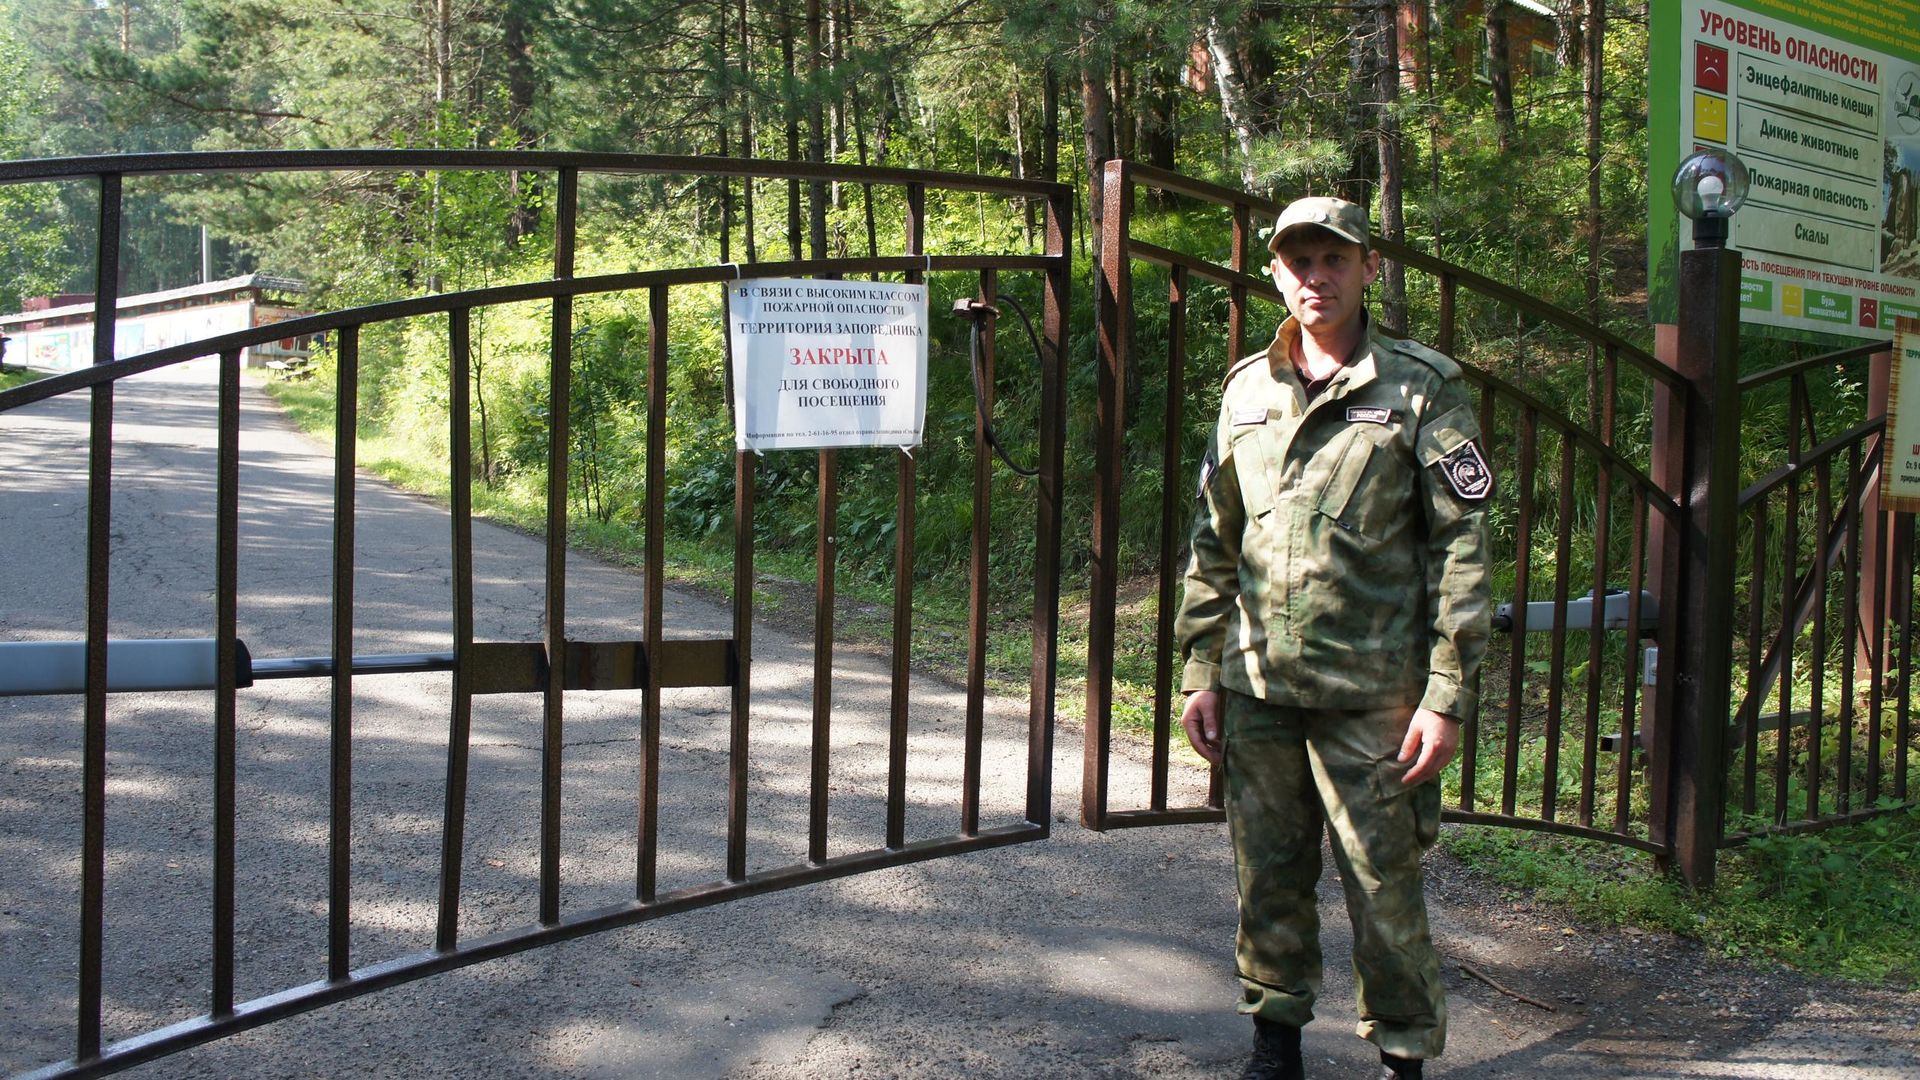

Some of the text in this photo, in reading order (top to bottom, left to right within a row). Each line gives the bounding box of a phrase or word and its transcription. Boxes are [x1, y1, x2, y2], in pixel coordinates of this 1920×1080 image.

[1699, 8, 1782, 56] УРОВЕНЬ
[1785, 36, 1878, 85] ОПАСНОСТИ
[1745, 65, 1874, 118] Энцефалитные клещи
[1759, 118, 1859, 161] Дикие животные
[1748, 167, 1869, 211] Пожарная опасность
[1794, 222, 1829, 246] Скалы
[1761, 261, 1805, 279] ПОСЕЩЕНИЯ
[1806, 269, 1821, 281] ПРИ
[1822, 272, 1853, 287] ТЕКУЩЕМ
[1855, 278, 1880, 292] УРОВНЕ
[1881, 282, 1916, 298] ОПАСНОСТИ
[740, 287, 920, 303] В СВЯЗИ С ВЫСОКИМ КЛАССОМ
[763, 301, 905, 316] ПОЖАРНОЙ ОПАСНОСТИ
[738, 322, 923, 337] ТЕРРИТОРИЯ ЗАПОВЕДНИКА
[790, 348, 888, 366] ЗАКРЫТА
[778, 378, 900, 392] ДЛЯ СВОБОДНОГО
[798, 395, 886, 408] ПОСЕЩЕНИЯ
